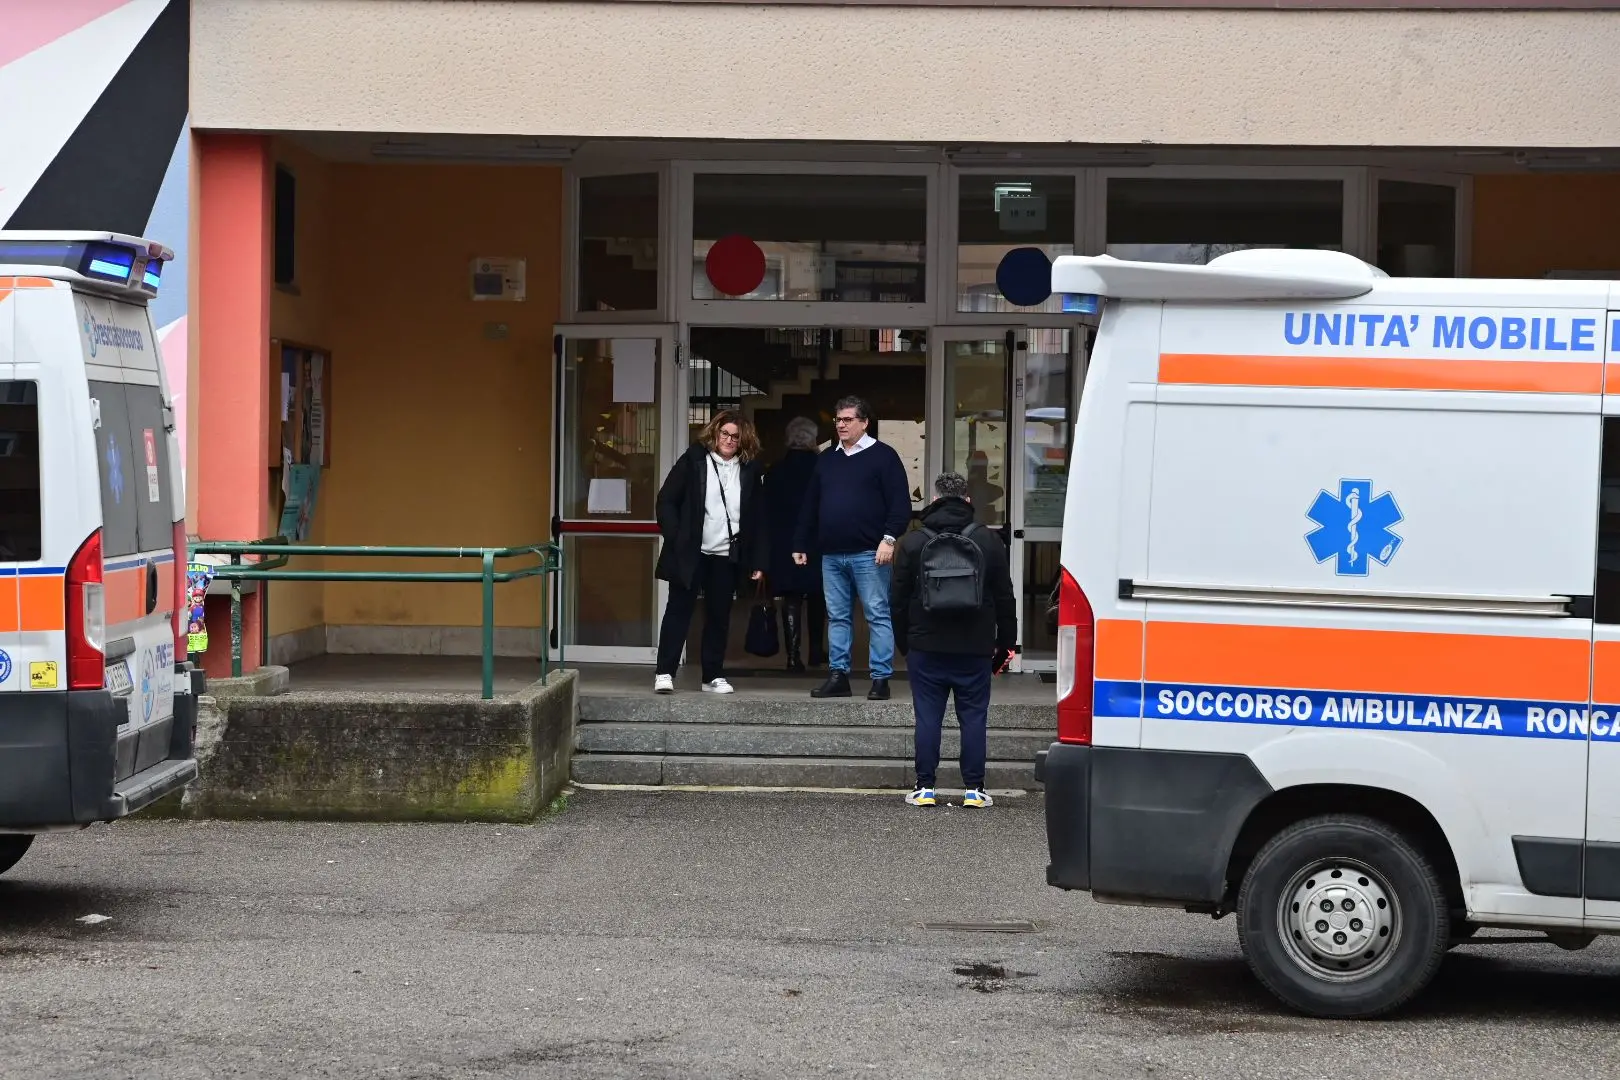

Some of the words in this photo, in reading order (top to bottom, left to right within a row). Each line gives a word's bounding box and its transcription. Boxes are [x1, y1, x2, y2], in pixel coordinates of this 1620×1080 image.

[1433, 315, 1596, 351] MOBILE
[1157, 689, 1313, 721] SOCCORSO
[1320, 697, 1503, 730] AMBULANZA
